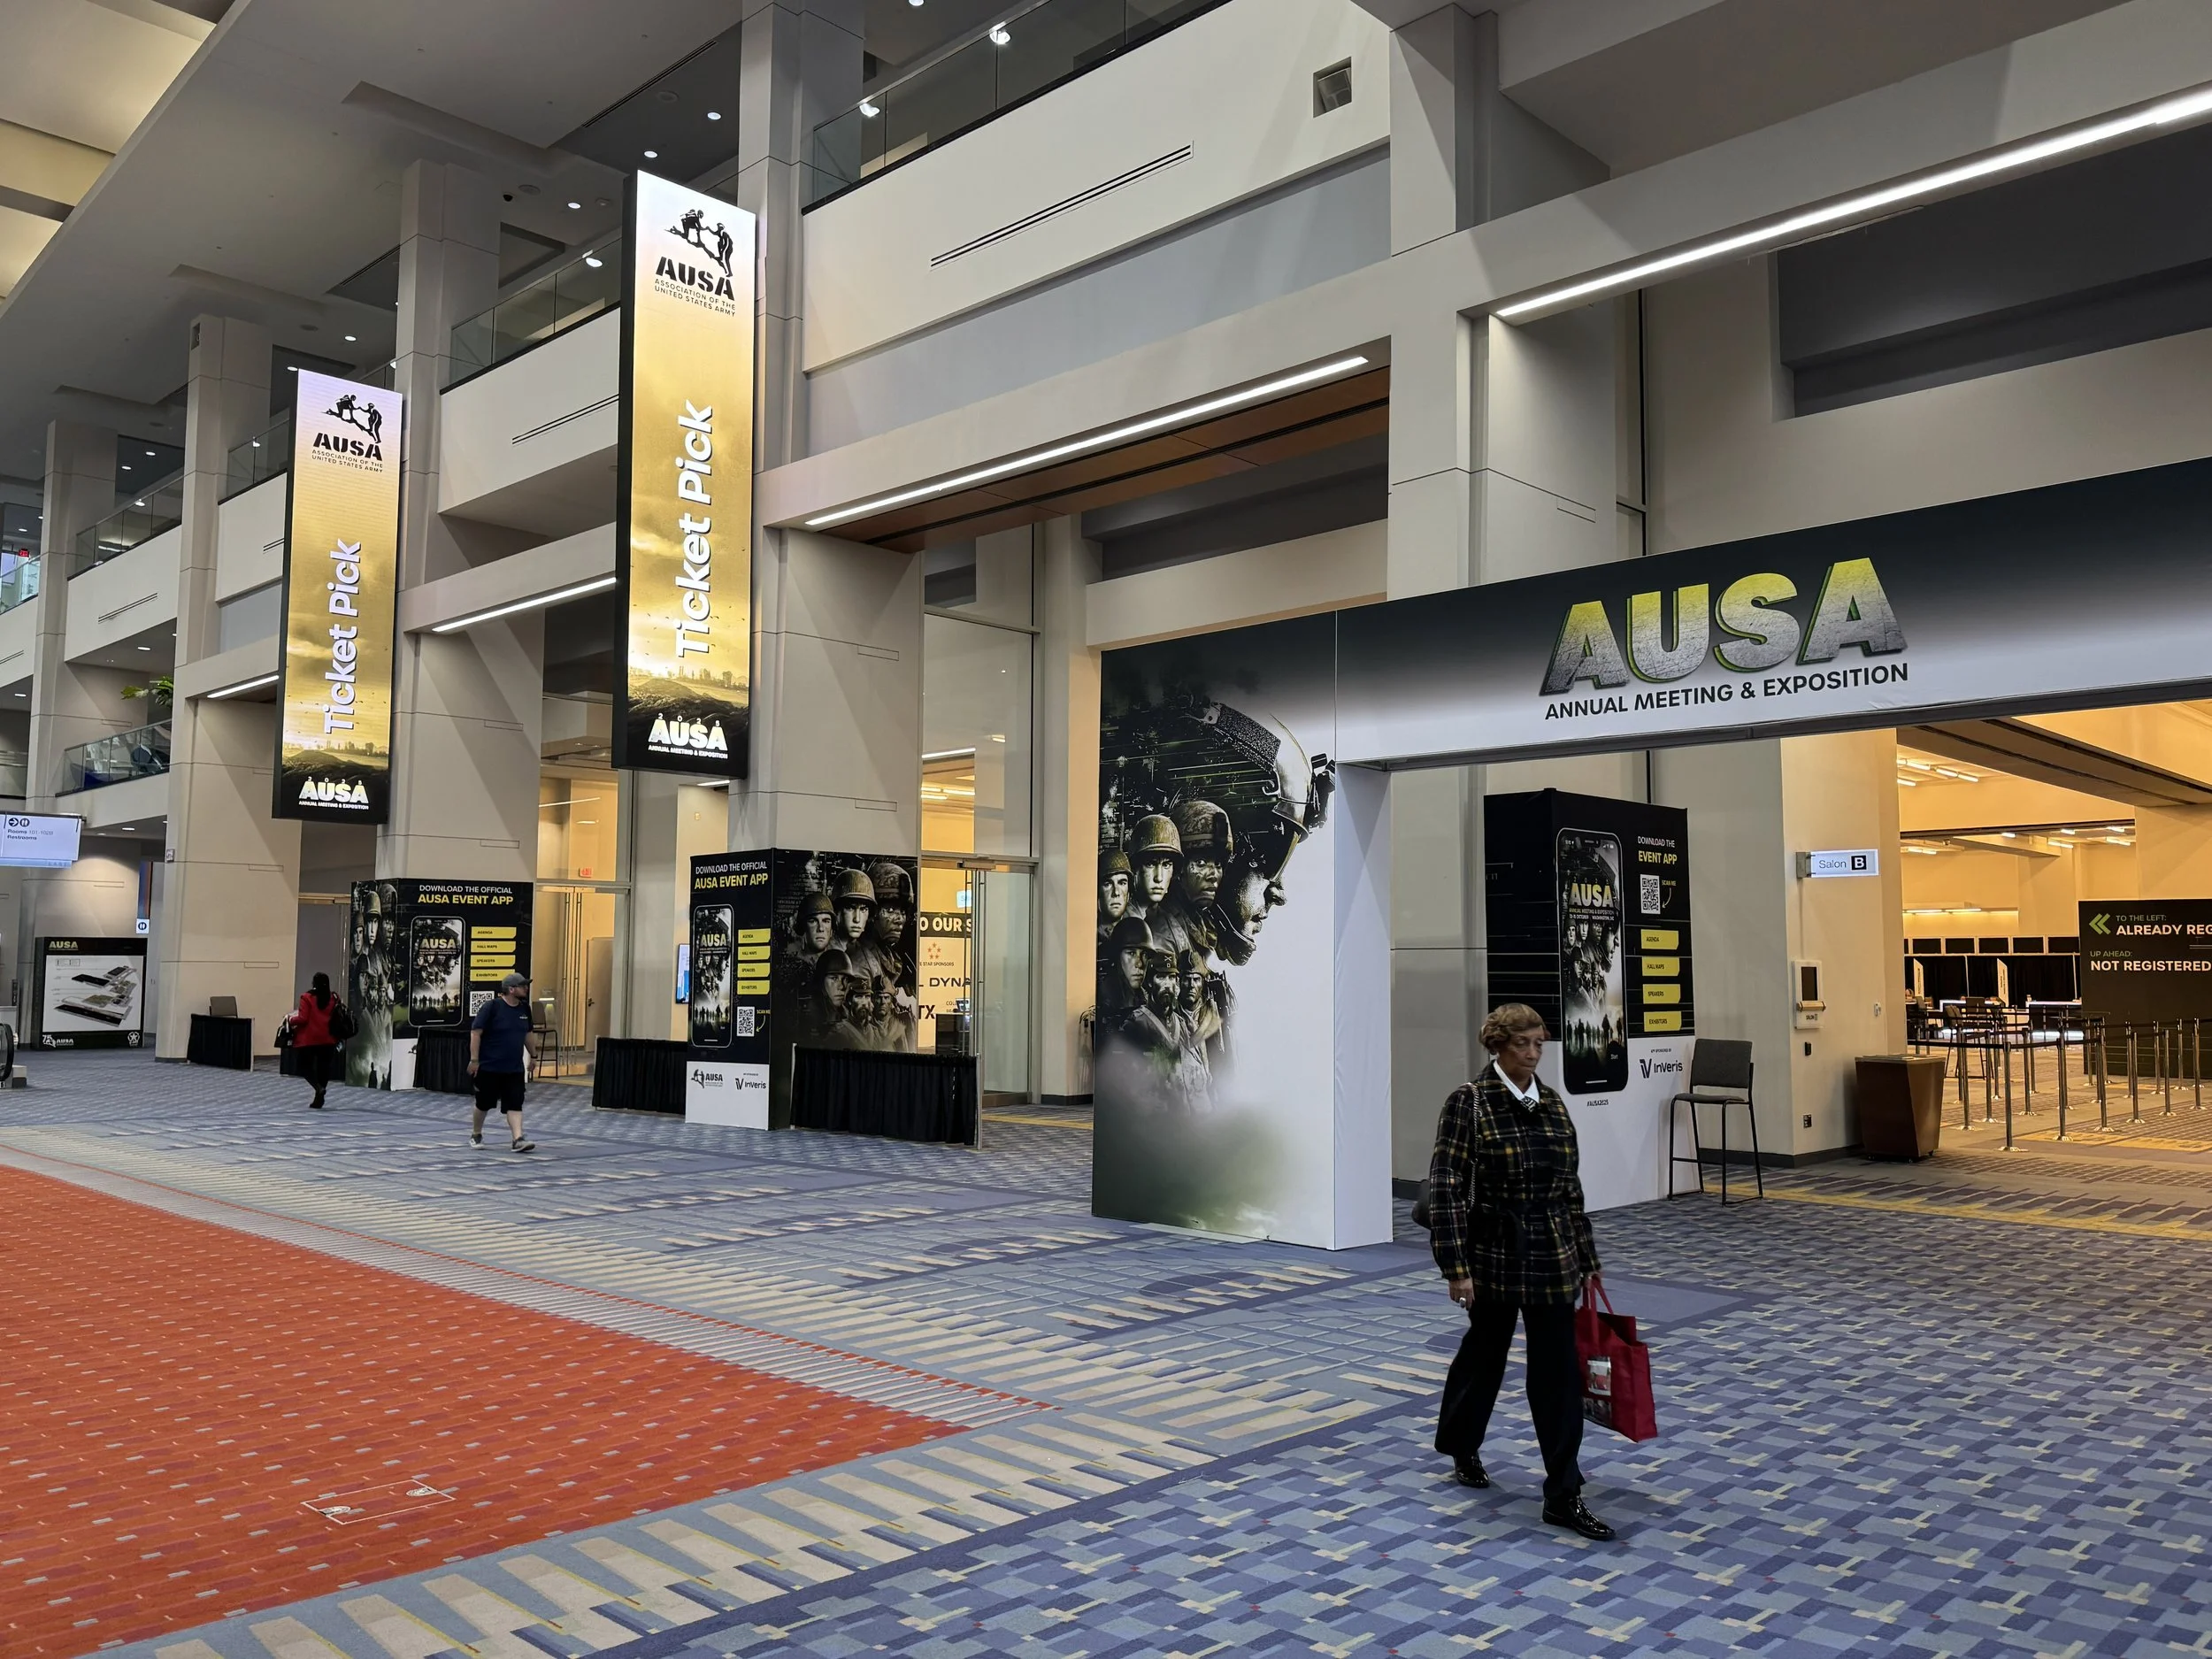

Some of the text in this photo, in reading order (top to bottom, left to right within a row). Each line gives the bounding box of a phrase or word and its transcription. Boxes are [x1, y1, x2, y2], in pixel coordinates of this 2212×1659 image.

[656, 256, 735, 301] AUSA
[655, 278, 706, 300] ASSOCIATION
[722, 301, 735, 310] THE
[655, 285, 735, 317] UNITED STATES ARMY
[313, 432, 383, 461] AUSA
[311, 449, 357, 463] ASSOCIATION
[311, 455, 337, 465] UNITED
[339, 460, 363, 470] STATES
[673, 399, 713, 657] Ticket Pick
[1539, 557, 1909, 697] AUSA
[321, 538, 361, 733] Ticket Pick
[1545, 663, 1909, 720] ANNUAL MEETING & EXPOSITION
[648, 718, 728, 751] AUSA
[299, 780, 369, 803] AUSA
[1637, 835, 1675, 848] DOWNLOAD THE
[1638, 850, 1678, 864] EVENT APP
[1819, 856, 1864, 869] Salon B
[695, 861, 767, 874] DOWNLOAD THE OFFICIAL
[694, 872, 768, 889] AUSA EVENT APP
[418, 894, 514, 905] AUSA EVENT APP
[1568, 882, 1614, 908] AUSA
[932, 917, 963, 932] OUR
[2116, 924, 2183, 936] ALREADY
[419, 938, 457, 949] AUSA
[701, 933, 726, 947] AUSA
[2090, 960, 2212, 972] NOT REGISTERED
[1654, 1060, 1683, 1073] InVeris
[705, 1072, 724, 1082] AUSA
[744, 1080, 767, 1089] InVeris
